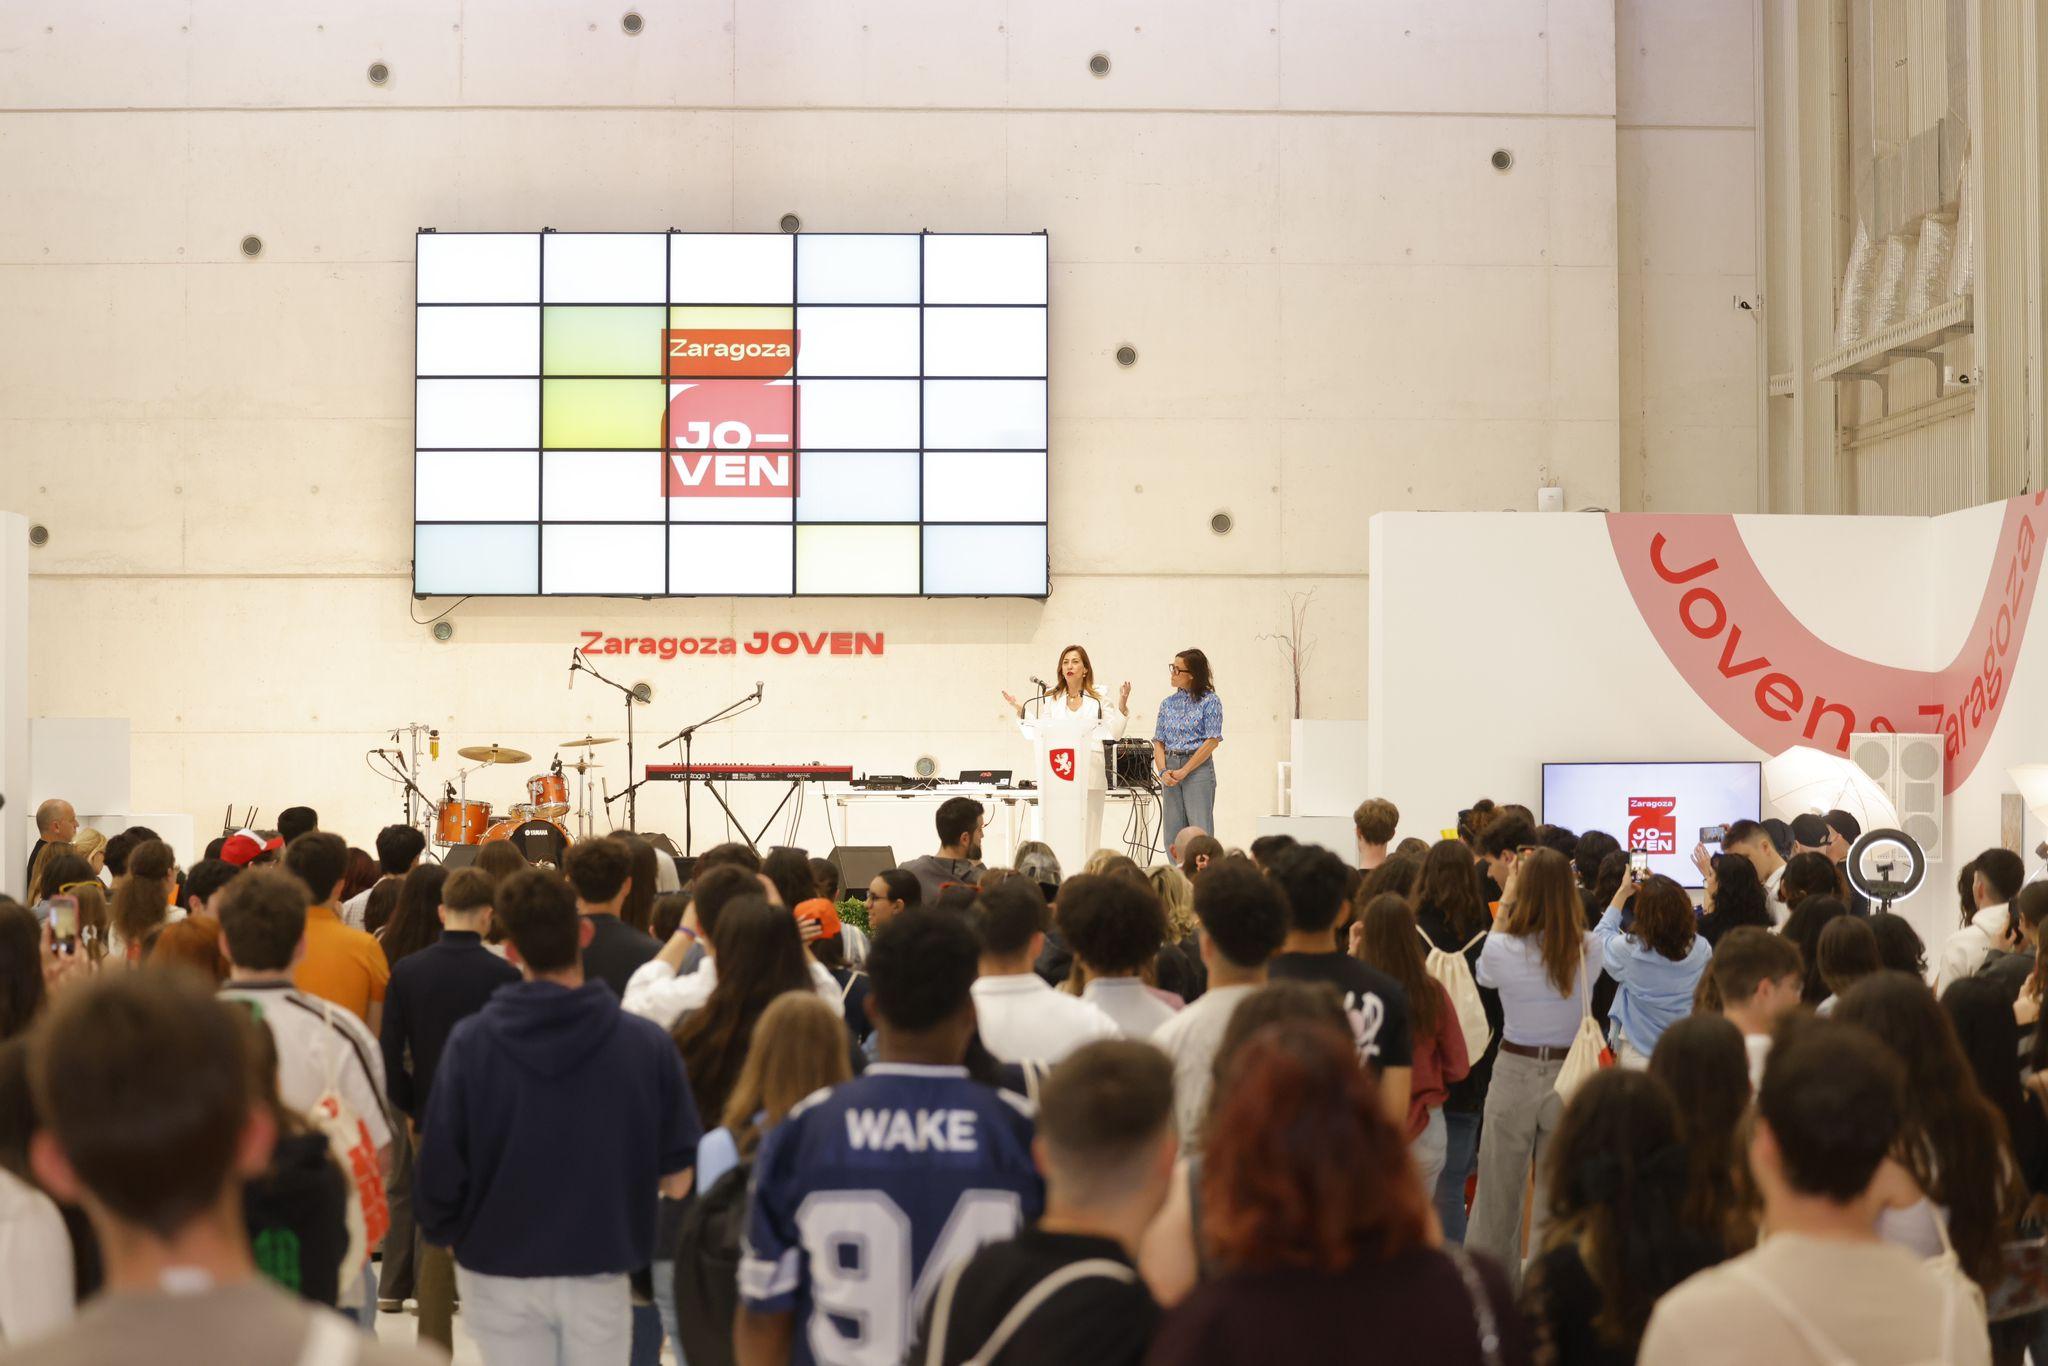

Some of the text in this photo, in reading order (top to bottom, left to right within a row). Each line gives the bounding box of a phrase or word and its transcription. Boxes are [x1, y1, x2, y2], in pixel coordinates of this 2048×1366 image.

[670, 338, 791, 361] Zaragoza
[670, 455, 789, 486] VEN
[580, 631, 884, 660] Zaragoza JOVEN
[1650, 532, 1856, 752] Joven
[1630, 800, 1673, 808] Zaragoza
[1631, 839, 1672, 851] VEN
[845, 1108, 978, 1152] WAKE
